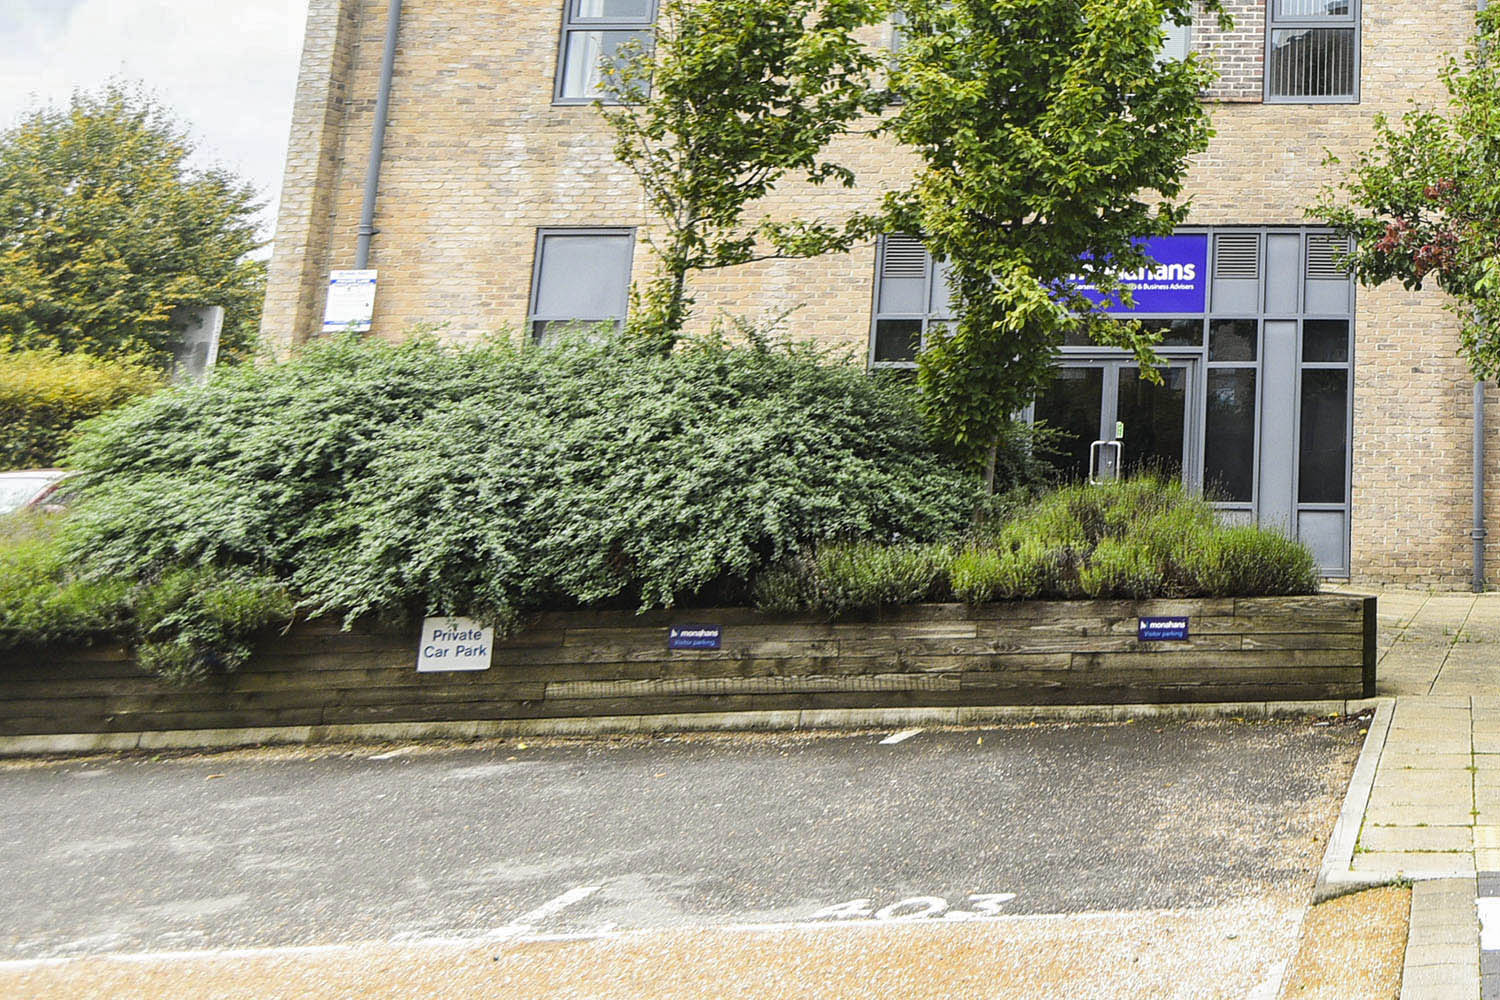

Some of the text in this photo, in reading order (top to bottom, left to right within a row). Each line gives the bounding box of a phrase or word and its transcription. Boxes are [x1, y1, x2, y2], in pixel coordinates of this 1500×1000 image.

[1150, 621, 1186, 629] monahans
[433, 629, 482, 641] Private
[680, 629, 719, 638] monahans
[424, 644, 487, 658] Car Park
